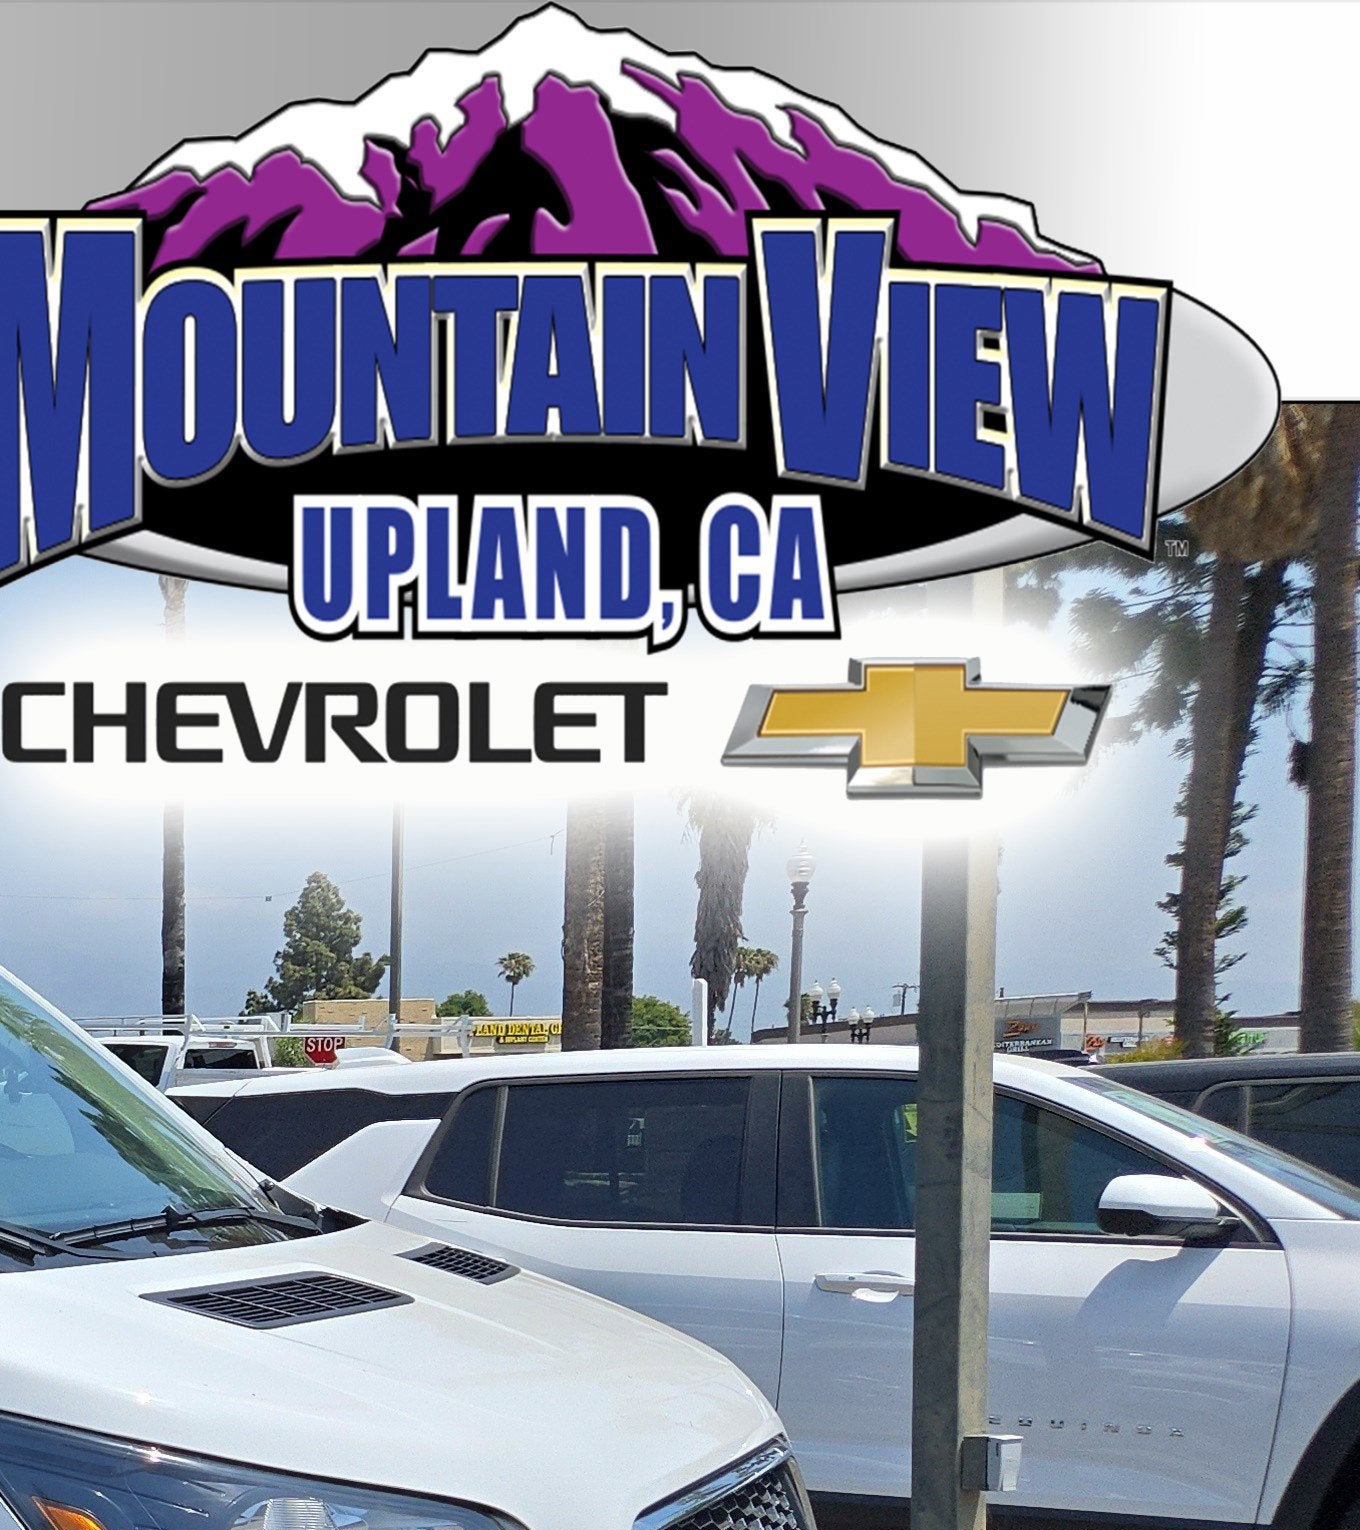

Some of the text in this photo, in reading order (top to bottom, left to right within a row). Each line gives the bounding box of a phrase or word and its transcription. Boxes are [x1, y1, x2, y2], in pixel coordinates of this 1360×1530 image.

[473, 1023, 506, 1037] LAND
[507, 1022, 548, 1037] DENTAL
[306, 1037, 343, 1052] STOP
